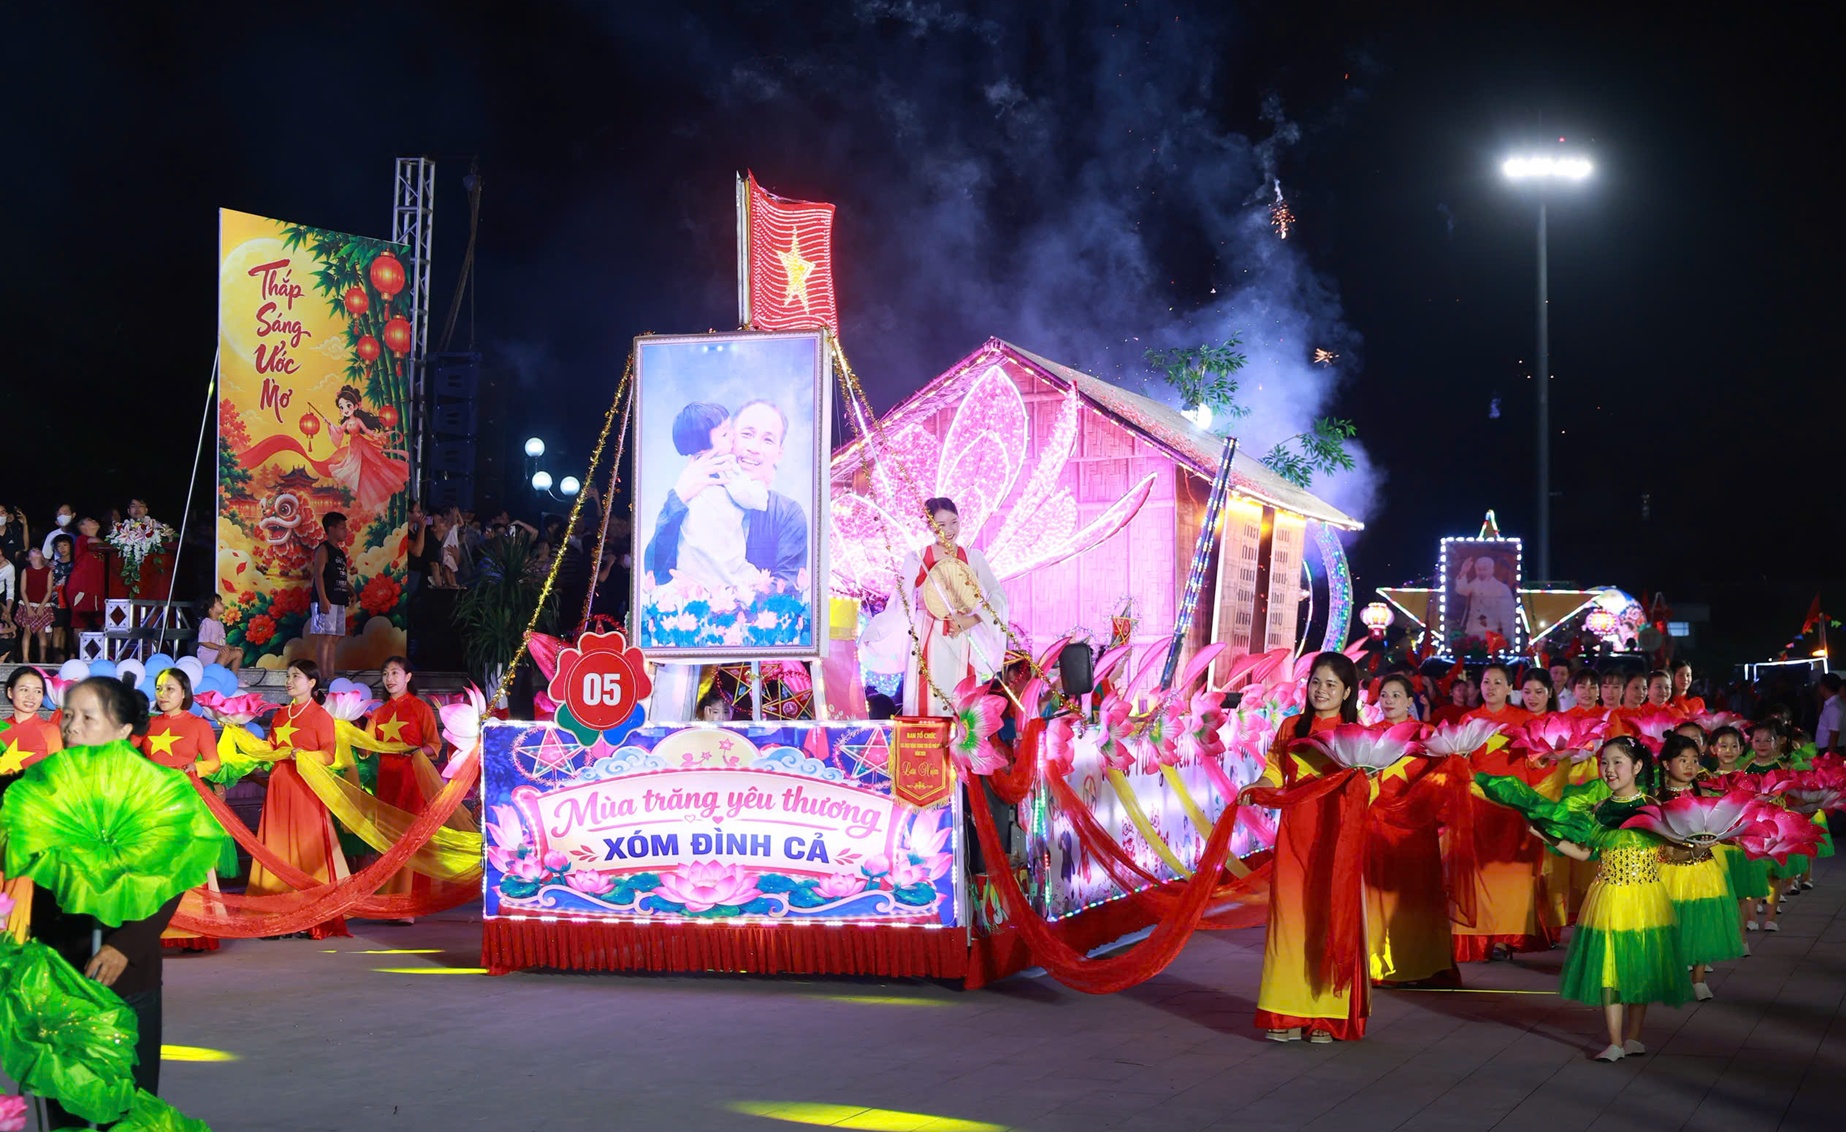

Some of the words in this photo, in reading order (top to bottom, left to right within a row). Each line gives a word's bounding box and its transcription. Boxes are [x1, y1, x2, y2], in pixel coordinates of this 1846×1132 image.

[248, 258, 305, 310] Thắp
[256, 301, 312, 348] Sáng
[253, 340, 302, 375] Ước
[582, 672, 622, 706] 05
[551, 791, 637, 838] Mùa
[642, 788, 721, 818] trăng
[726, 785, 776, 818] yêu
[782, 785, 882, 839] thương
[602, 829, 679, 861] XÓM
[690, 827, 771, 857] ĐÌNH
[783, 832, 830, 864] CẢ
